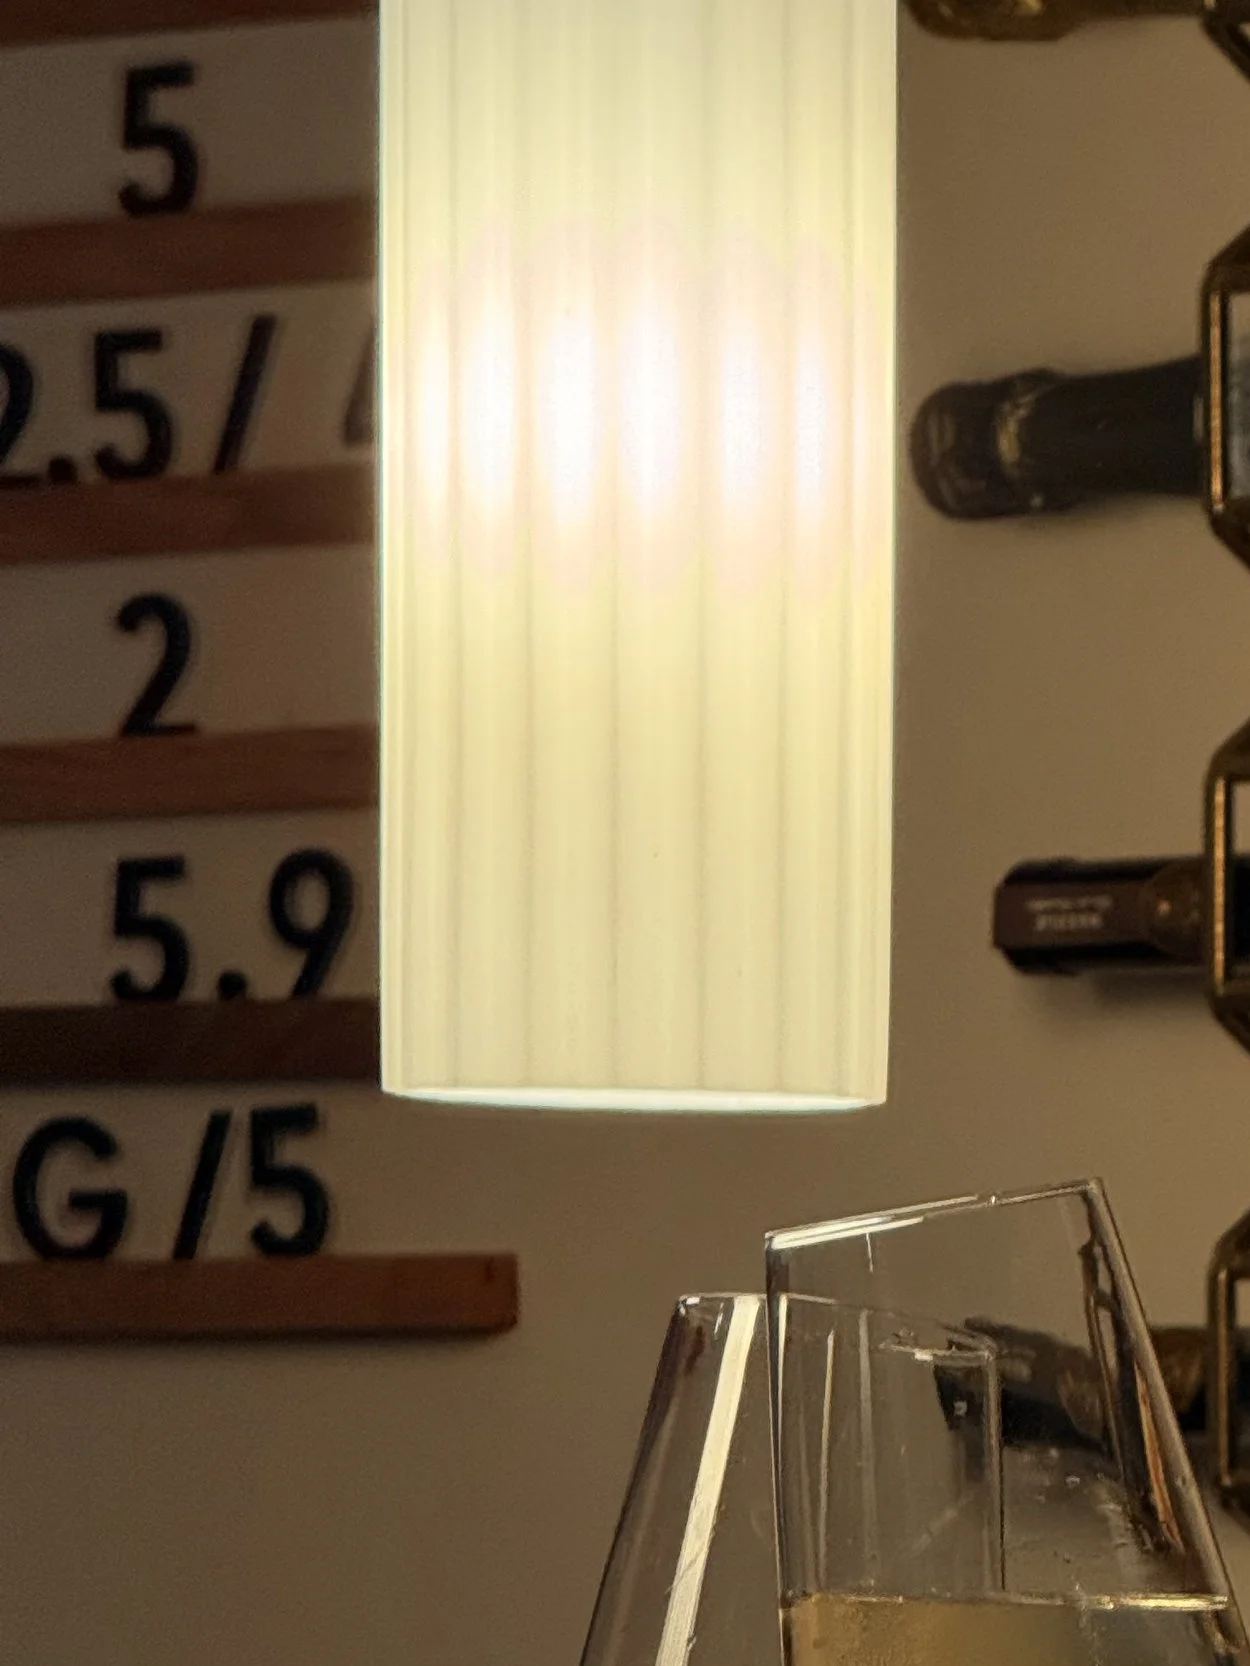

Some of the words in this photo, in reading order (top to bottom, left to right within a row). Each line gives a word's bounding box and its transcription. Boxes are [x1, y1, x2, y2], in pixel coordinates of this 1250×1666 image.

[119, 61, 199, 218] 5
[117, 593, 197, 737] 2
[111, 848, 353, 1002] 5.9
